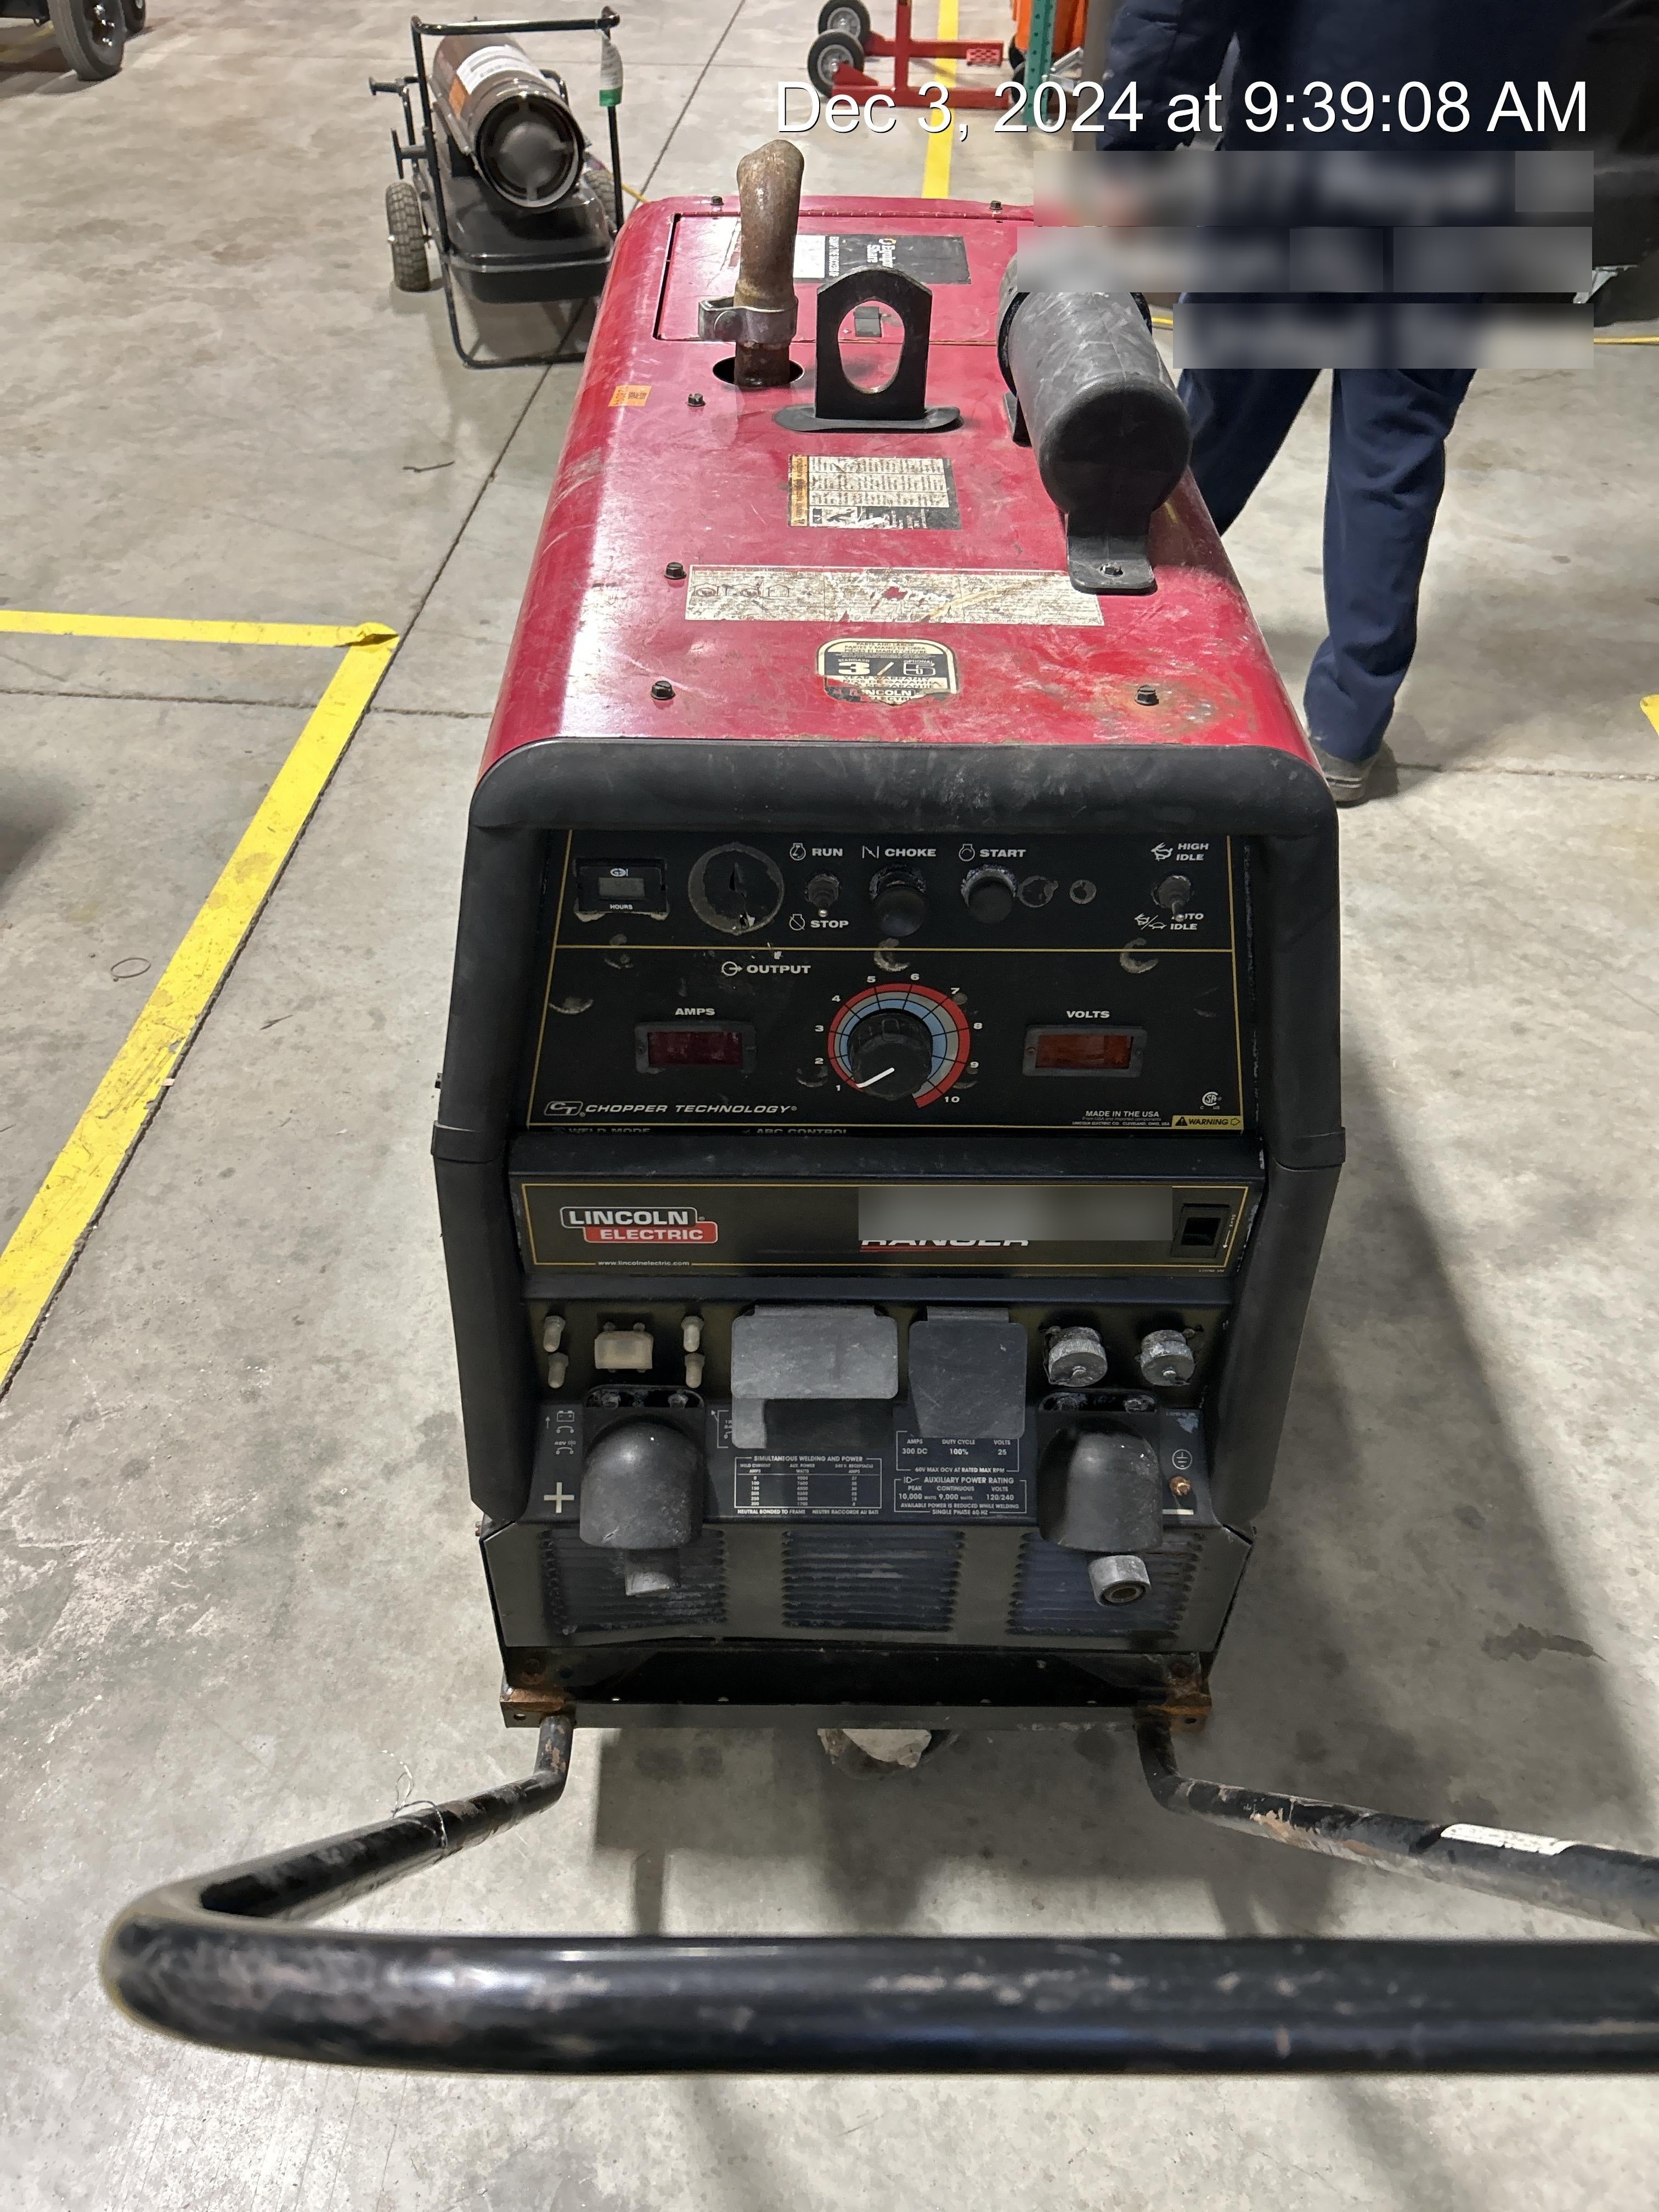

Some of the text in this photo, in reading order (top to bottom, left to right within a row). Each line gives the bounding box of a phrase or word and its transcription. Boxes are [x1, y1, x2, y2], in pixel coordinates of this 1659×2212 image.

[838, 662, 870, 675] 3
[812, 848, 843, 856] RUN
[885, 848, 936, 856] CHOKE
[980, 849, 1026, 857] START
[810, 920, 849, 928] STOP
[747, 965, 811, 974] OUTPUT
[585, 1104, 668, 1113] CHOPPER
[569, 1211, 688, 1224] LINCOLN
[600, 1229, 703, 1240] ELECTRIC
